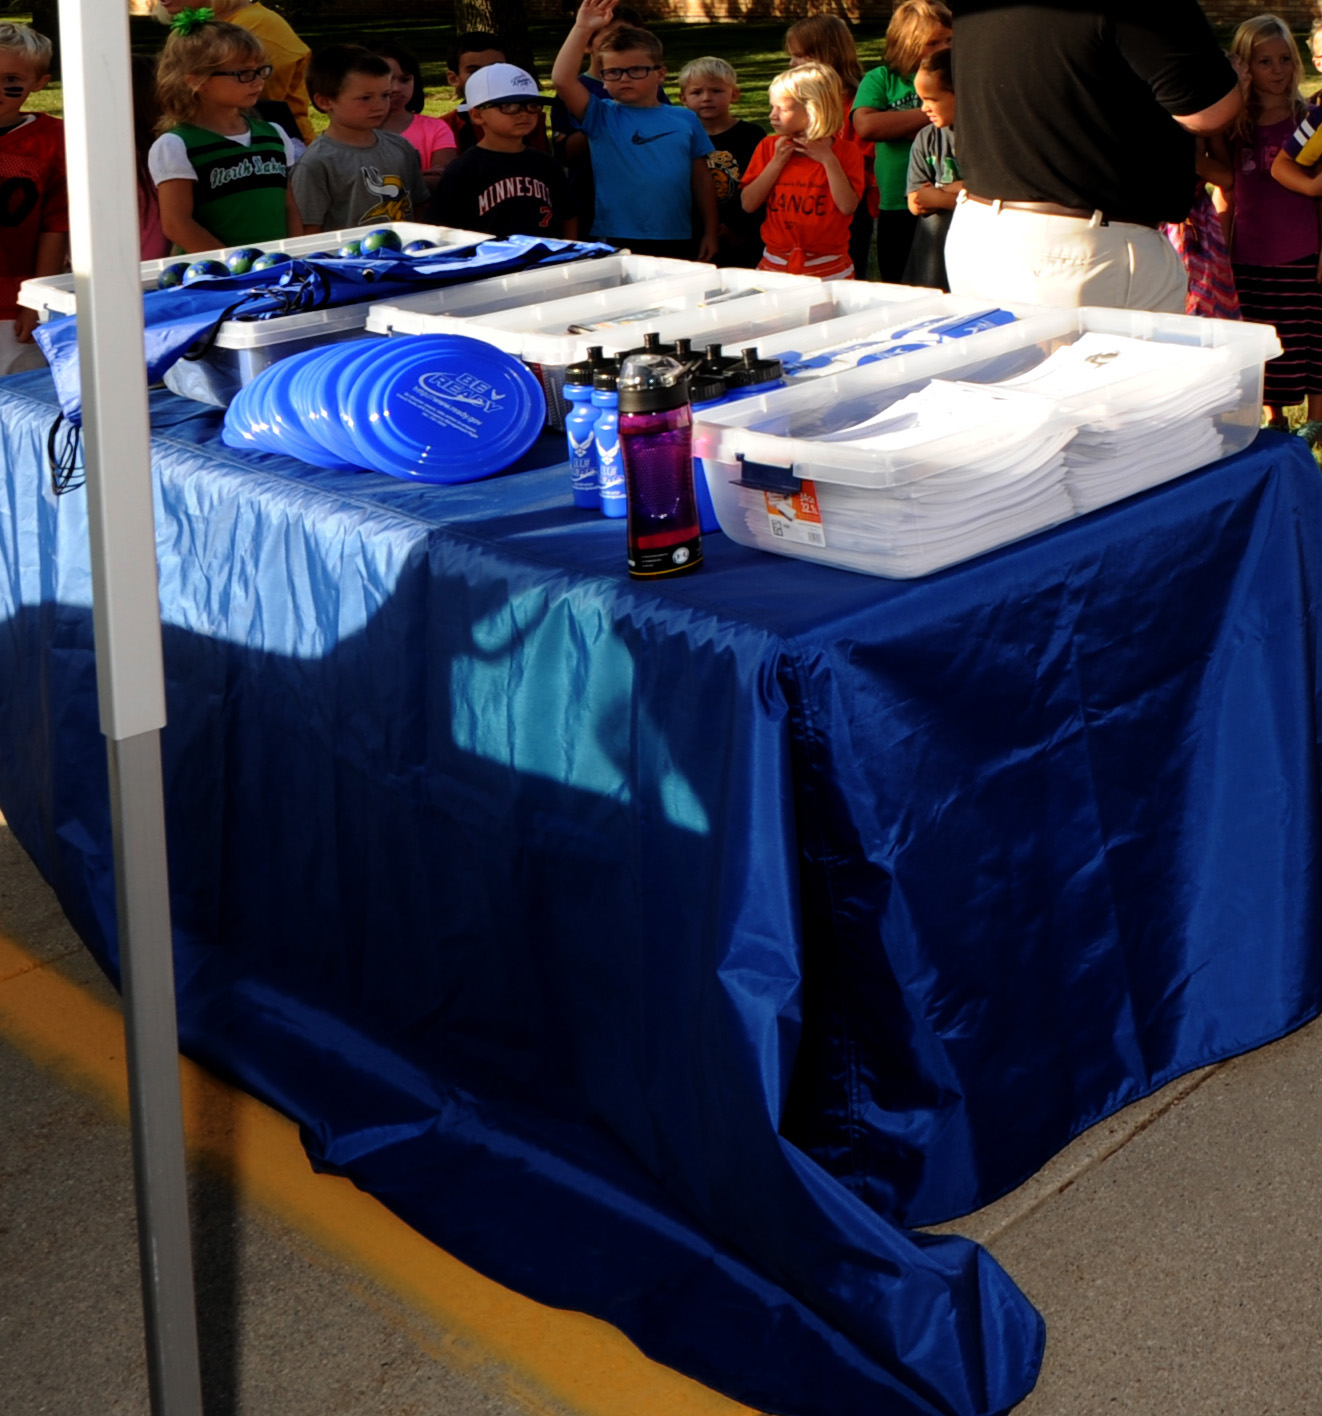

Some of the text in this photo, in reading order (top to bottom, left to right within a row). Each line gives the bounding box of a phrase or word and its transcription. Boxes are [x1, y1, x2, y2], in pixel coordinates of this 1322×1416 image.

[538, 205, 553, 228] 7
[428, 374, 505, 414] READY
[455, 372, 492, 394] BE
